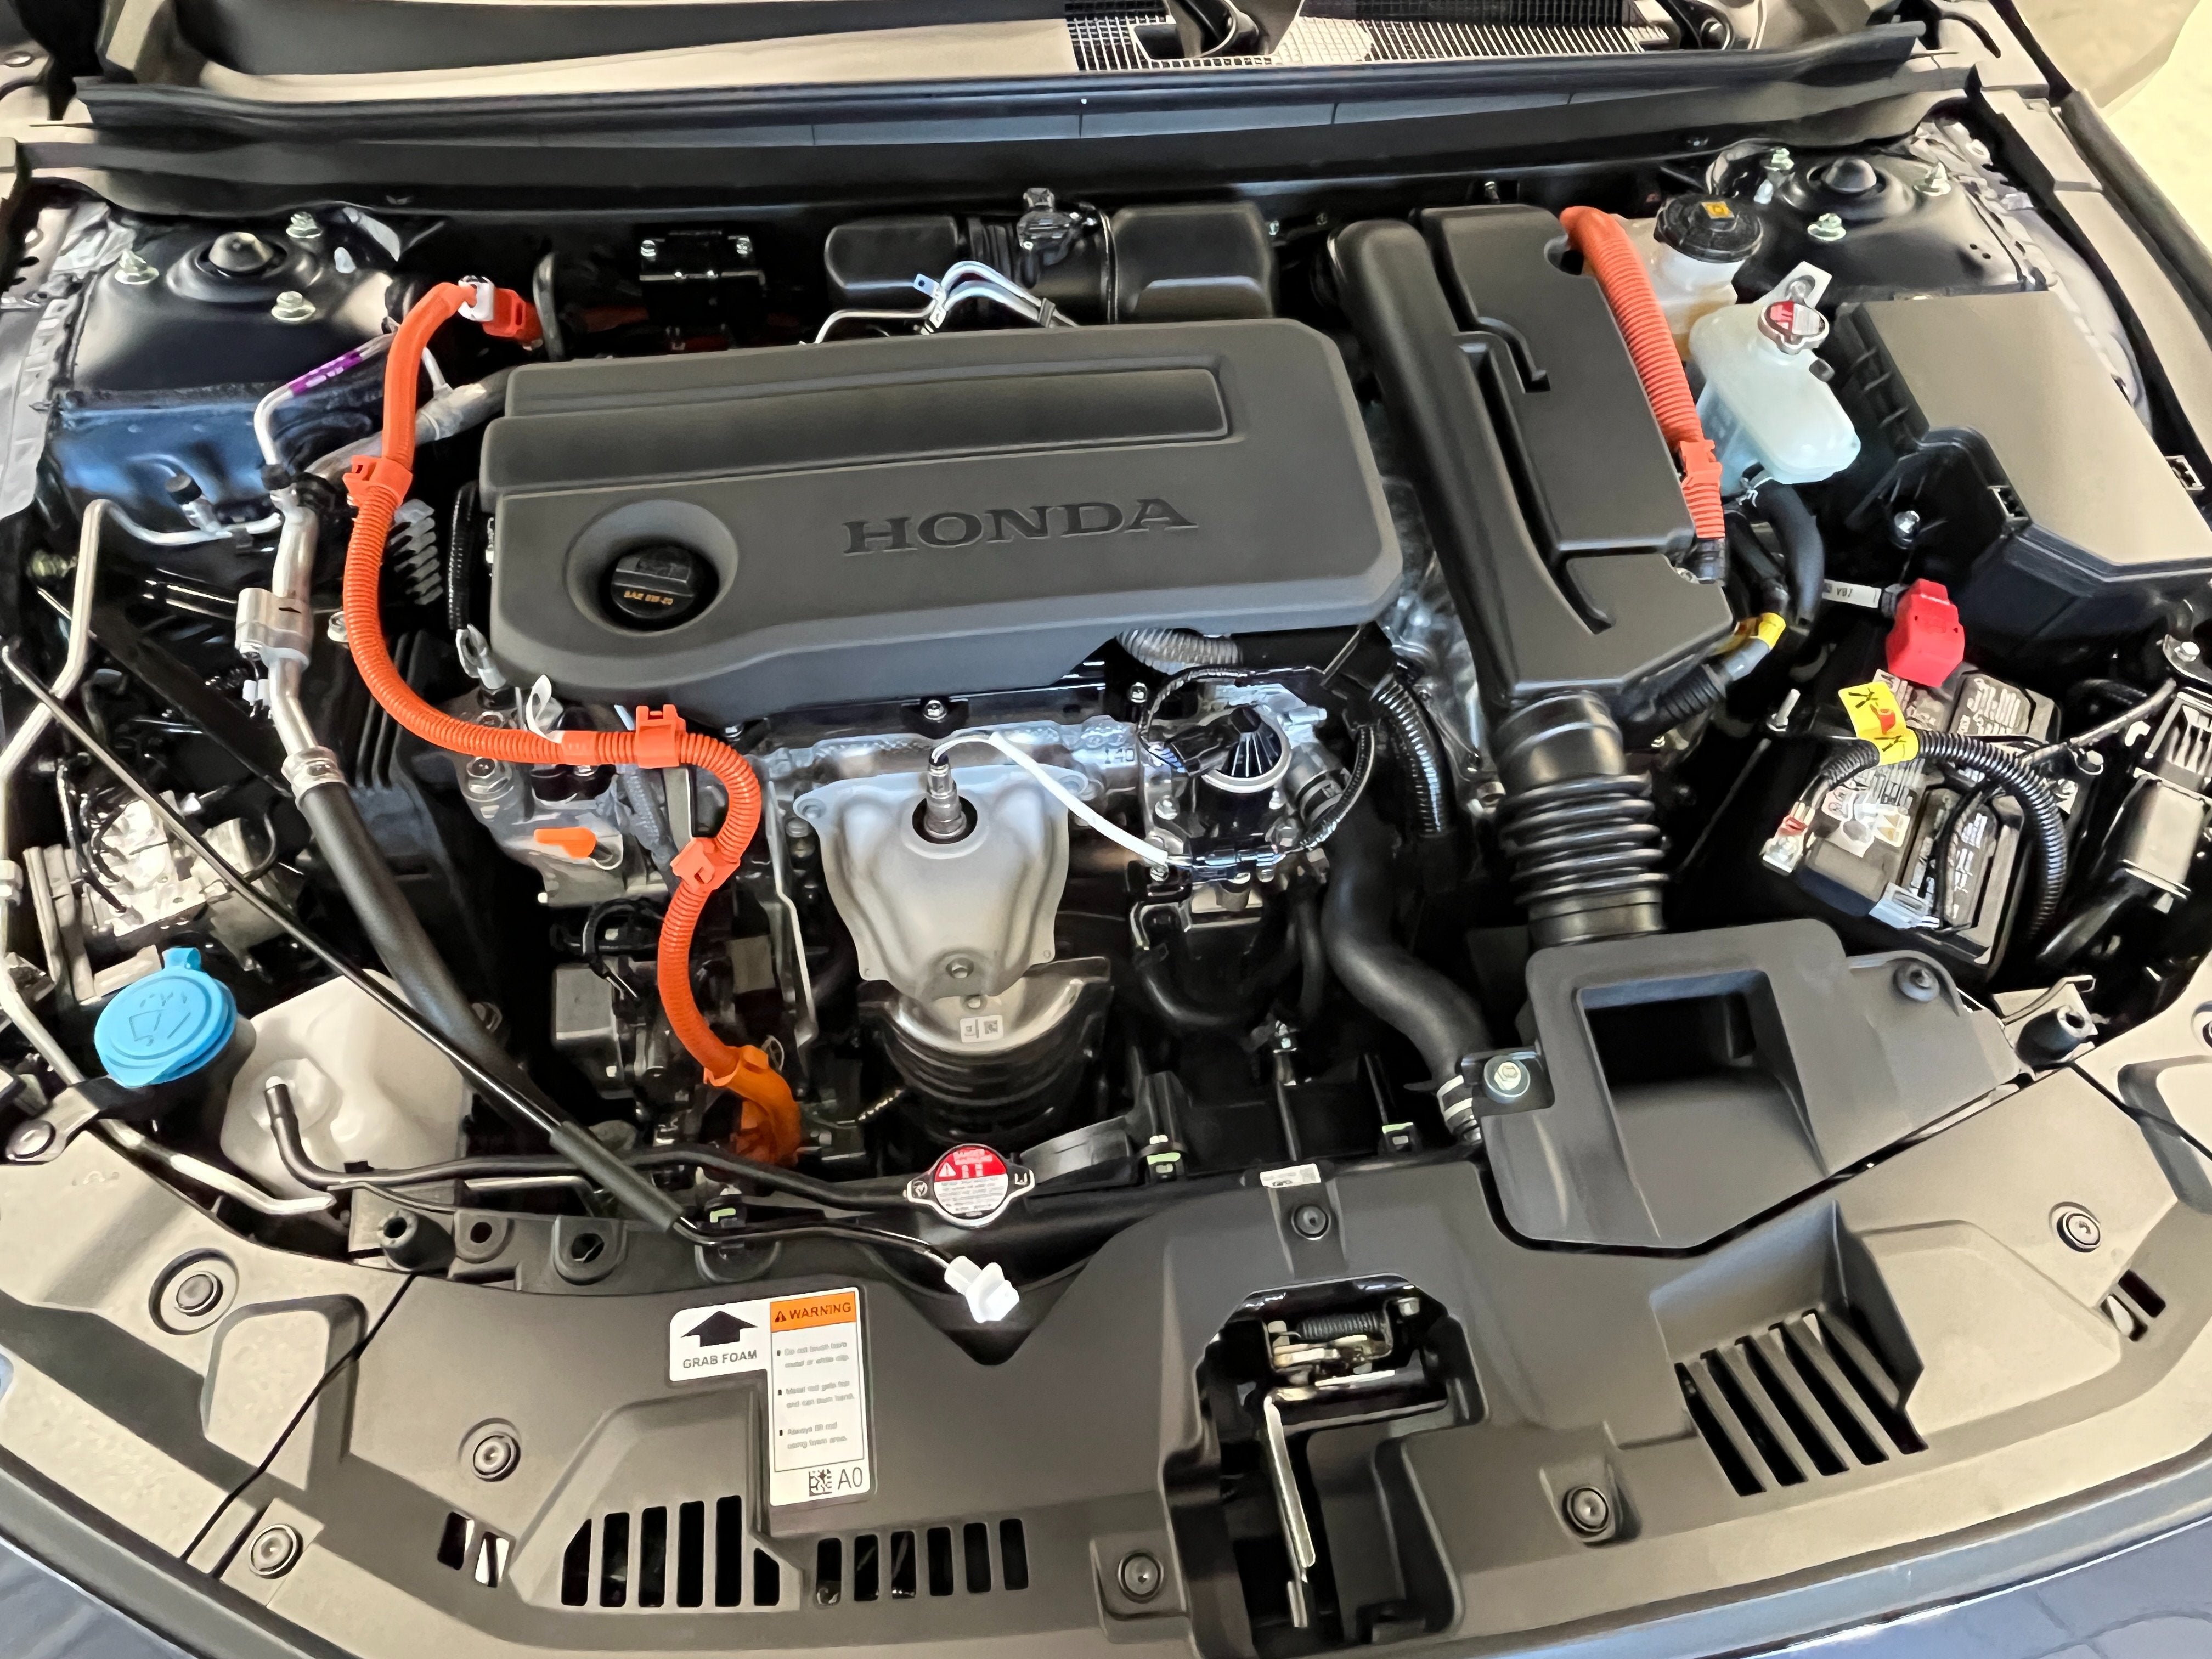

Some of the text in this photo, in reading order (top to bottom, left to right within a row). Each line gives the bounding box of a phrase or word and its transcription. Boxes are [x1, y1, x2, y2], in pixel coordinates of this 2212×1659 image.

[843, 498, 1199, 556] HONDA
[789, 1302, 851, 1319] WARNING
[682, 1349, 758, 1369] GRAB FOAM
